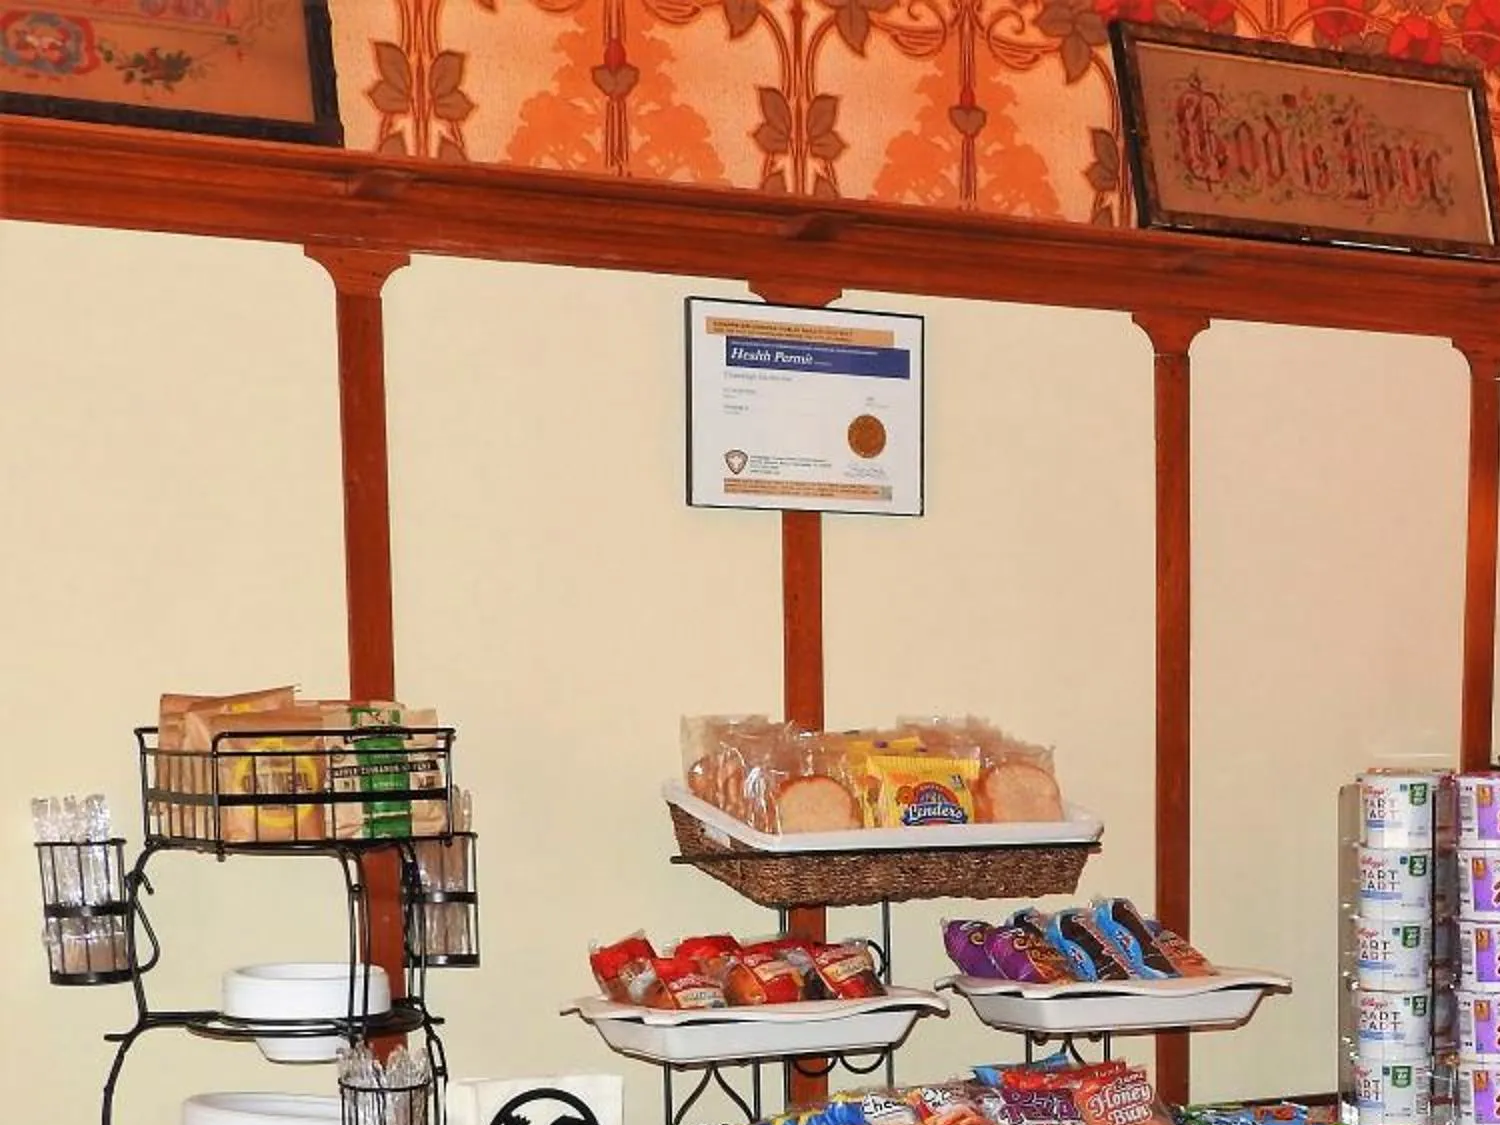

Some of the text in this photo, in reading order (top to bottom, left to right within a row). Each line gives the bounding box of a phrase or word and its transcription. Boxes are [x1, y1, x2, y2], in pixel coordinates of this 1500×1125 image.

[730, 347, 771, 362] Health
[774, 352, 815, 366] Permit
[1088, 1082, 1154, 1117] Honey
